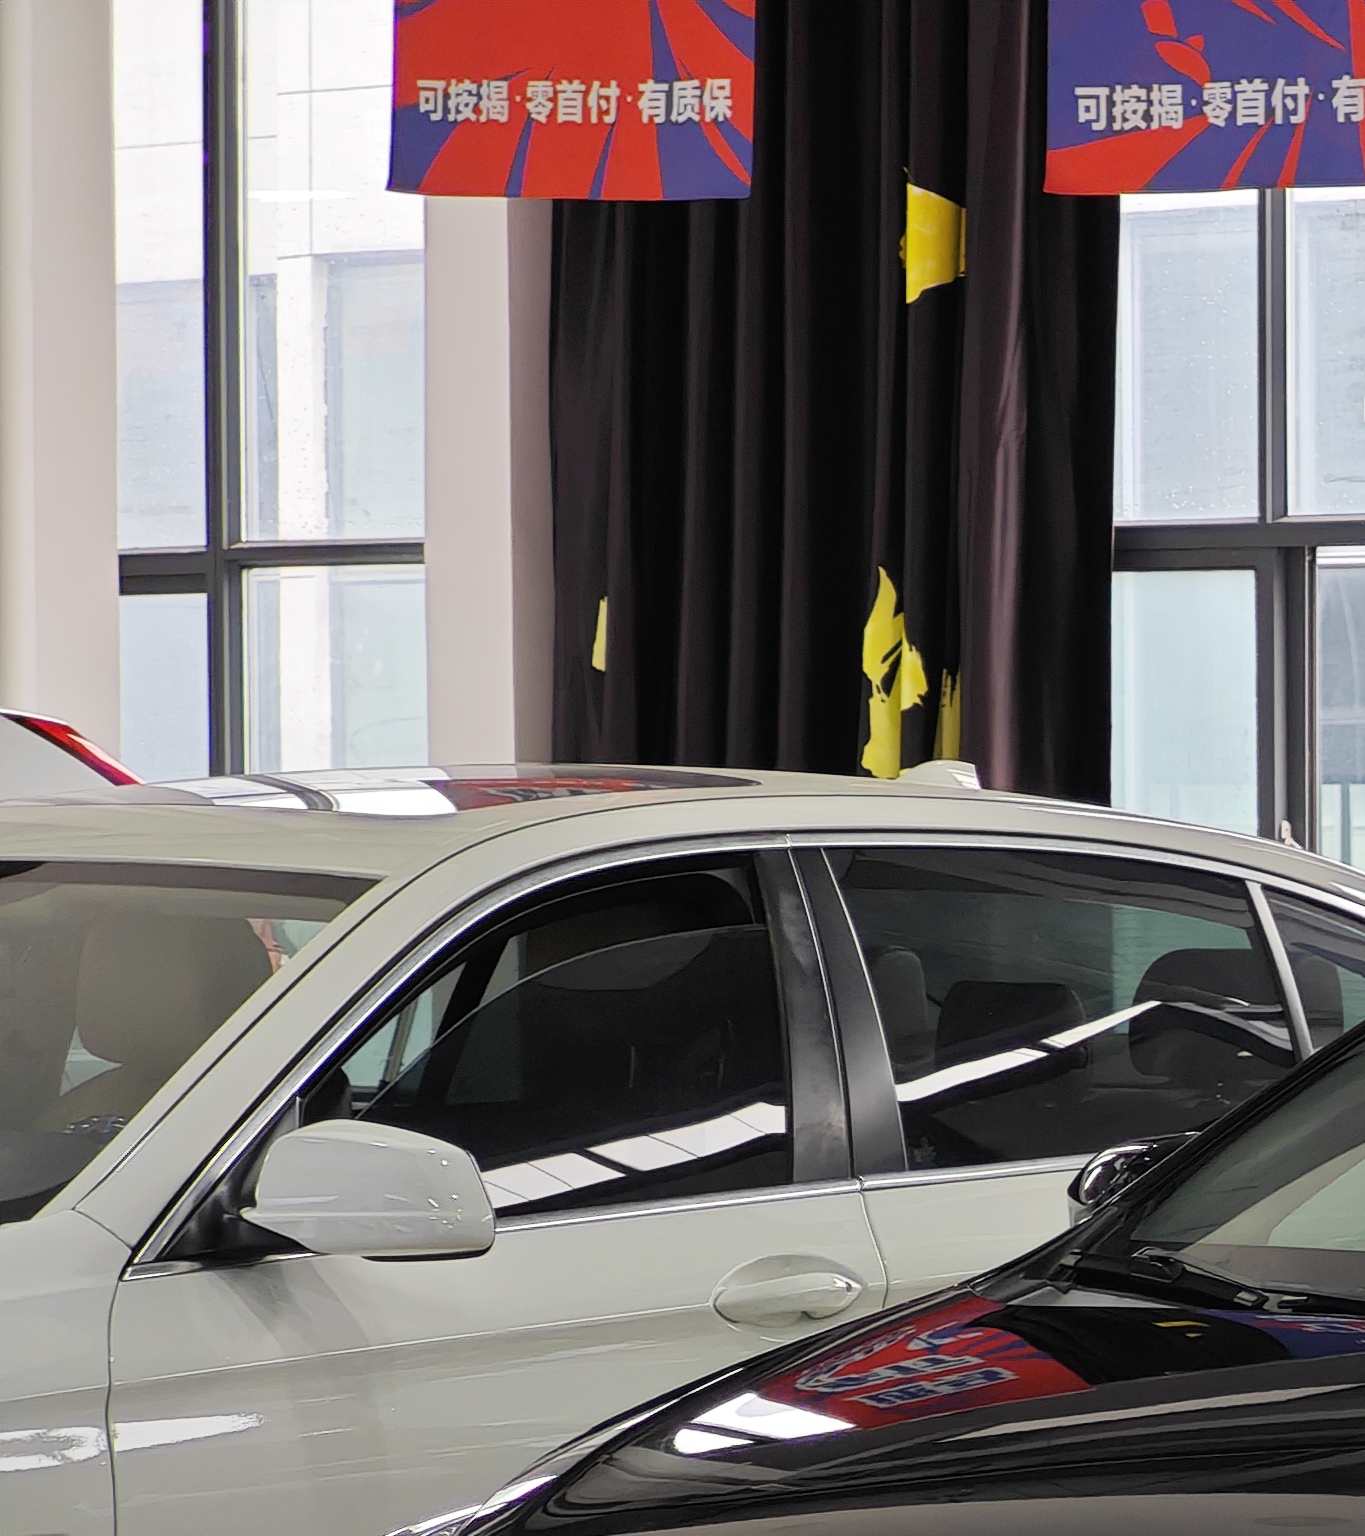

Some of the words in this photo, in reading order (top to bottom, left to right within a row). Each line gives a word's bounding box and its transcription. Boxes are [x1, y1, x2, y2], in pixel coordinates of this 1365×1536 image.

[416, 78, 734, 125] 可按揭·零首付·有质保
